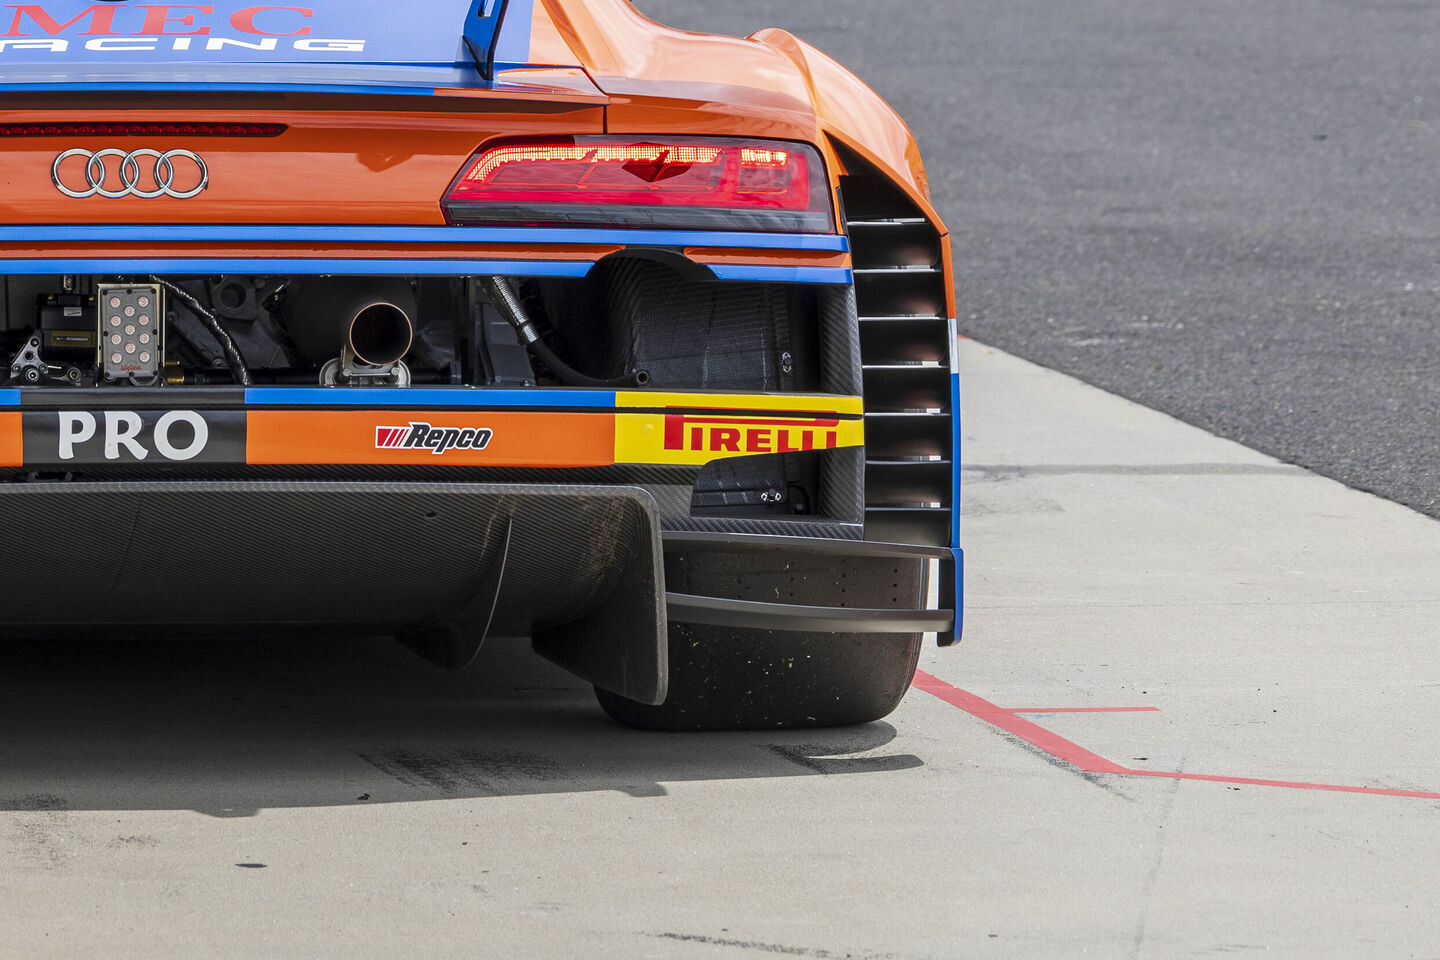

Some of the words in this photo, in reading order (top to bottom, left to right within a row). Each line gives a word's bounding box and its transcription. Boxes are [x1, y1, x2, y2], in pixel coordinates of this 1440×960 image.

[58, 410, 209, 461] PRO
[406, 423, 494, 455] Repco
[664, 406, 839, 452] PIRELLI
